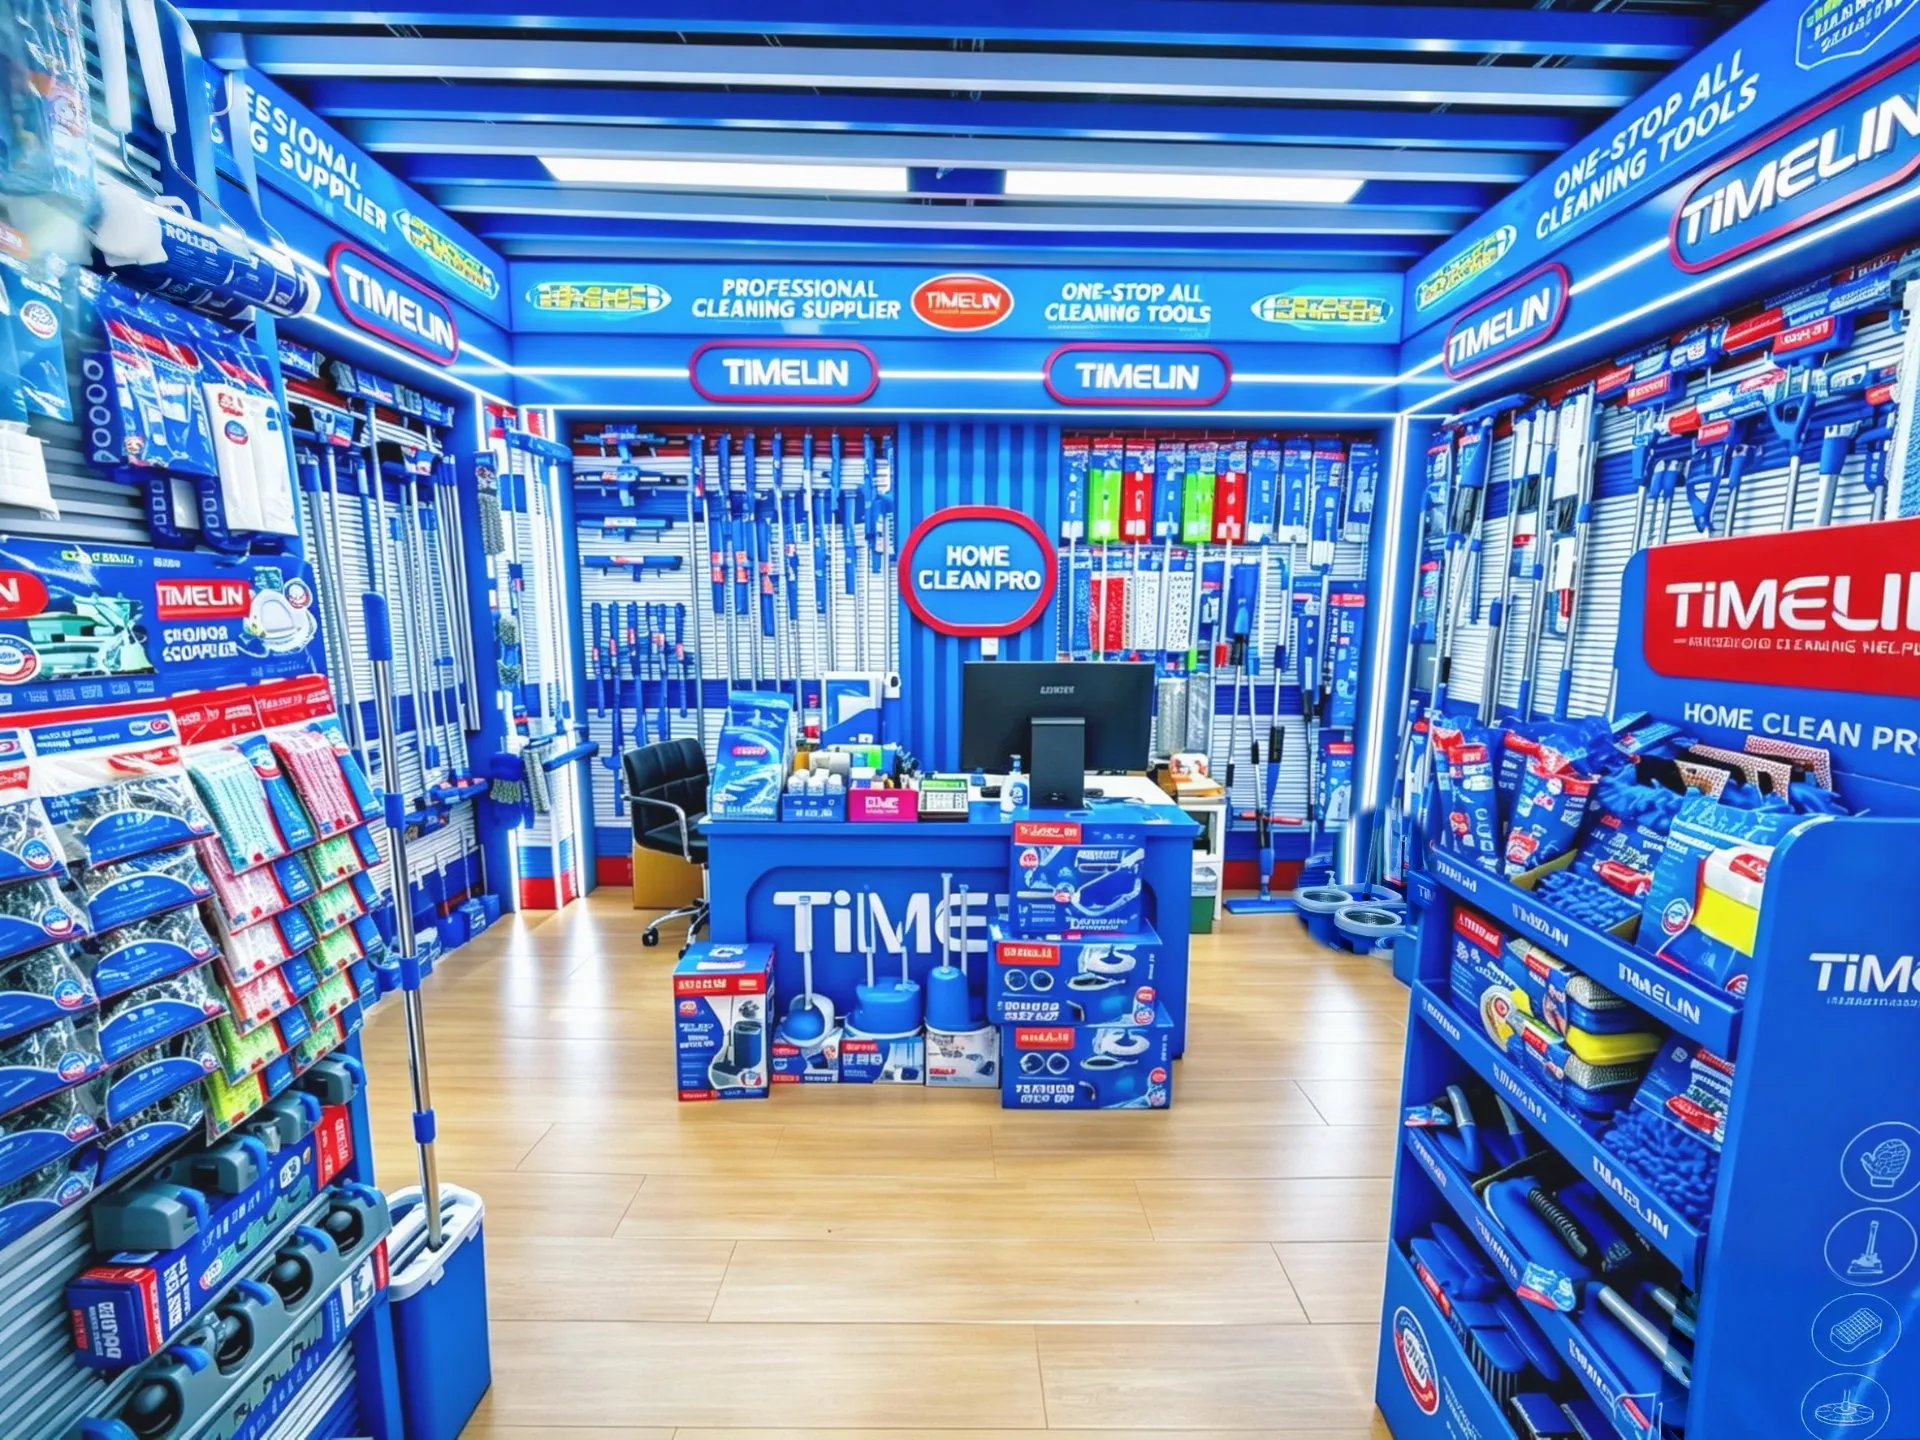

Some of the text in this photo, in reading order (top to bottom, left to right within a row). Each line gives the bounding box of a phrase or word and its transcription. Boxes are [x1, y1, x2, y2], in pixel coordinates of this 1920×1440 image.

[1554, 48, 1744, 199] ONE-STOP ALL
[1536, 72, 1760, 240] CLEANING TOOLS
[279, 141, 388, 234] SUPPLIER
[166, 223, 218, 255] ROLLER
[722, 278, 879, 299] PROFESSIONAL
[1061, 282, 1205, 303] ONE-STOP ALL
[691, 298, 901, 320] CLEANING SUPPLIER
[1044, 302, 1212, 323] CLEANING TOOLS
[722, 357, 849, 387] TIMELIN
[1075, 362, 1200, 391] TIMELIN
[918, 569, 1042, 590] CLEAN PRO
[1684, 702, 1754, 731] HOME
[1762, 712, 1862, 748] CLEAN
